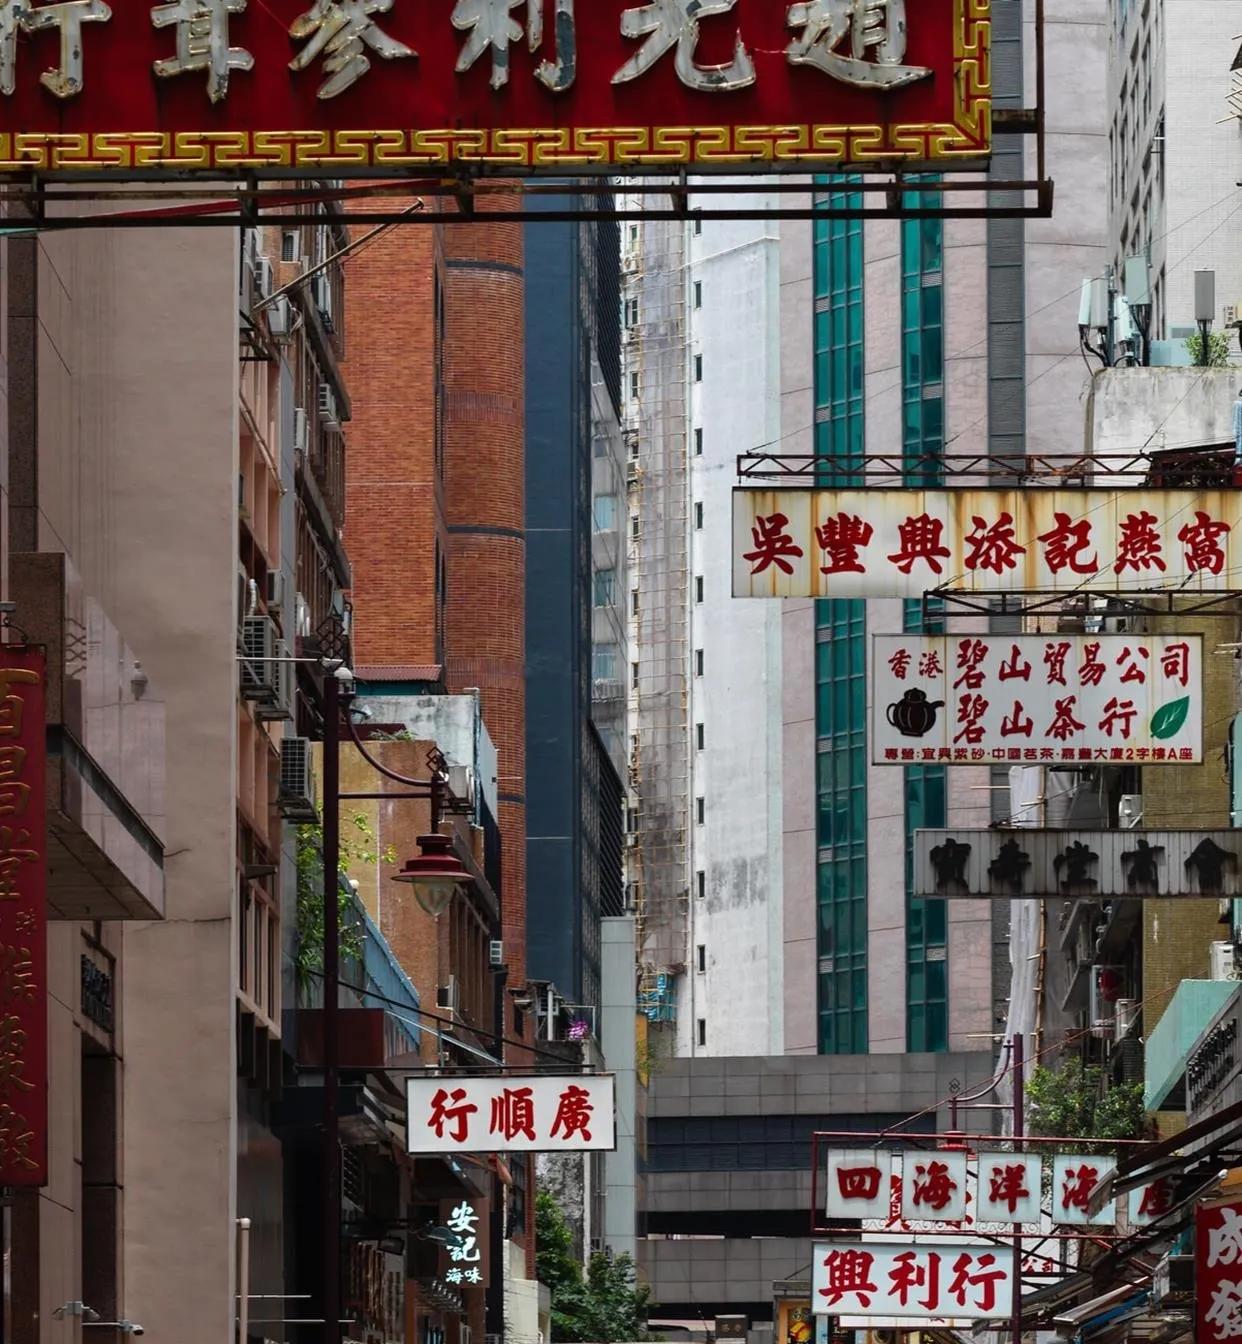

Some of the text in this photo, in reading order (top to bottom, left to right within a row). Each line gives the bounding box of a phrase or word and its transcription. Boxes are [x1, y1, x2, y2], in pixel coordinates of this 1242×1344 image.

[743, 512, 1231, 575] 吳豐興添記燕窩
[953, 693, 1137, 744] 碧山茶行
[428, 1085, 594, 1143] 廣順行
[447, 1201, 480, 1262] 安記
[446, 1267, 484, 1284] 海味
[818, 1249, 1007, 1312] 興利行
